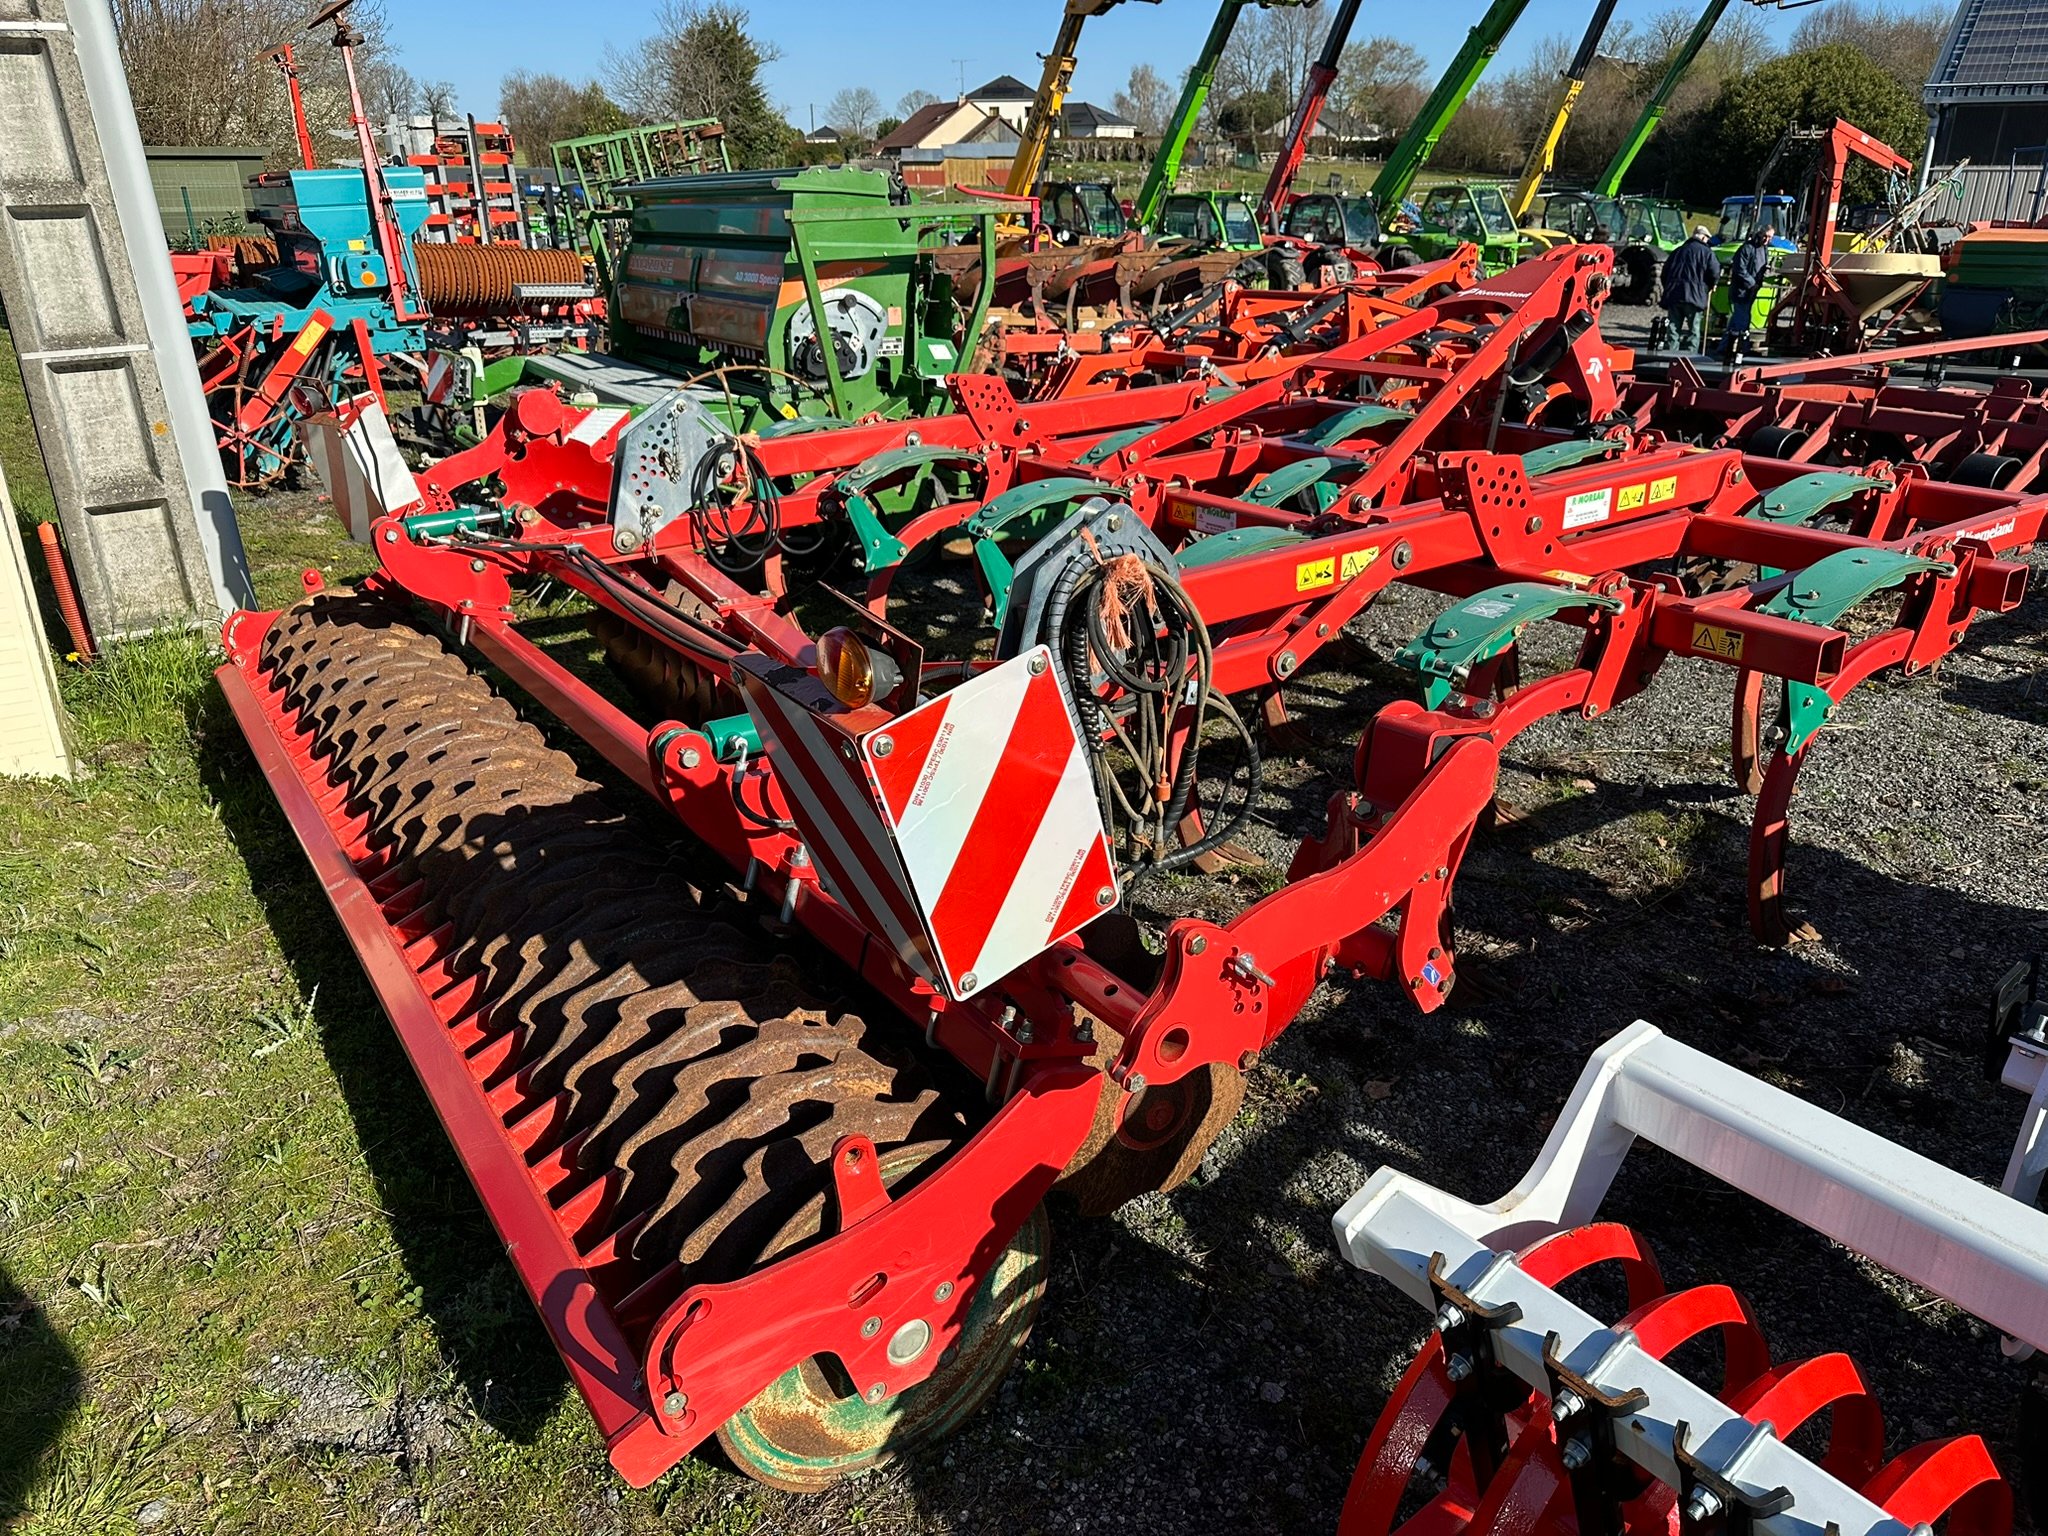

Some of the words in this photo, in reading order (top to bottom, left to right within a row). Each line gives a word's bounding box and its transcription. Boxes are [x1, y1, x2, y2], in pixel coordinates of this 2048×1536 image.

[1026, 96, 1046, 142] DIECI
[1525, 156, 1537, 178] NEW
[1534, 113, 1556, 156] HOLLAND
[759, 273, 780, 286] Specia
[1578, 491, 1606, 504] MOREAU
[1965, 517, 2016, 541] erneland
